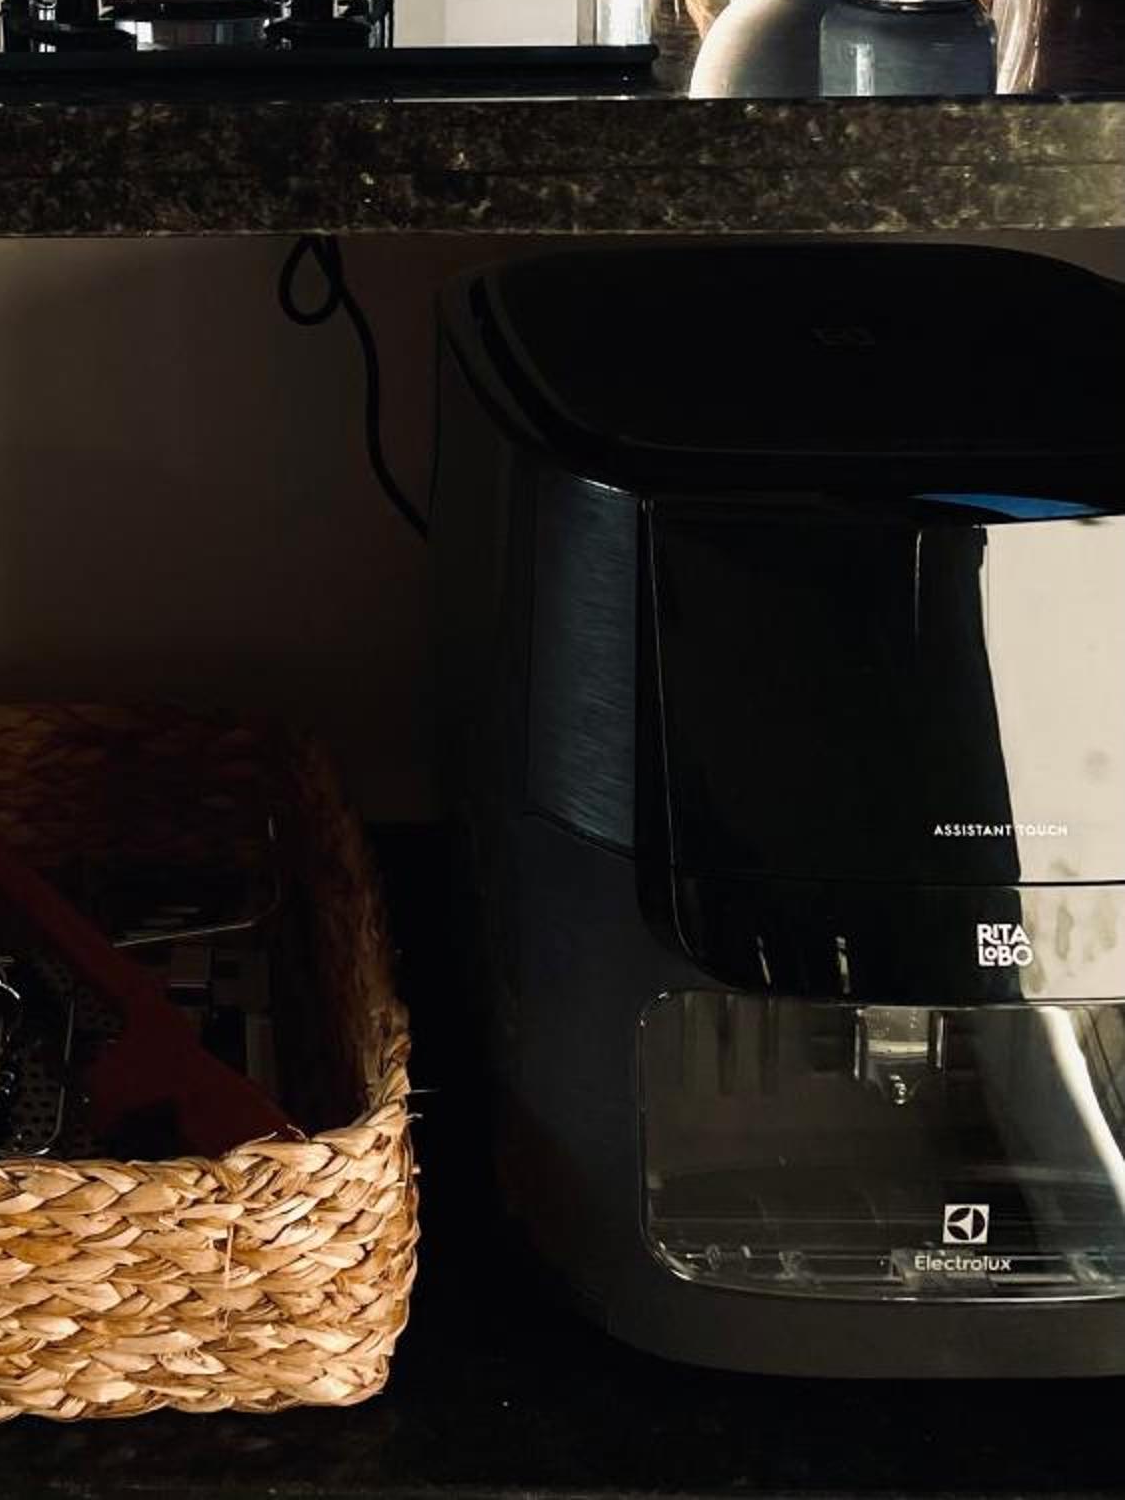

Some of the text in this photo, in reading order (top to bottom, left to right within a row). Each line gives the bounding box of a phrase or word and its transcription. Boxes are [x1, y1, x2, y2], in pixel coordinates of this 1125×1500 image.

[933, 824, 1068, 837] ASSISTANT TOUCH
[976, 923, 1031, 945] RITA
[914, 1255, 1012, 1272] Electrolux
